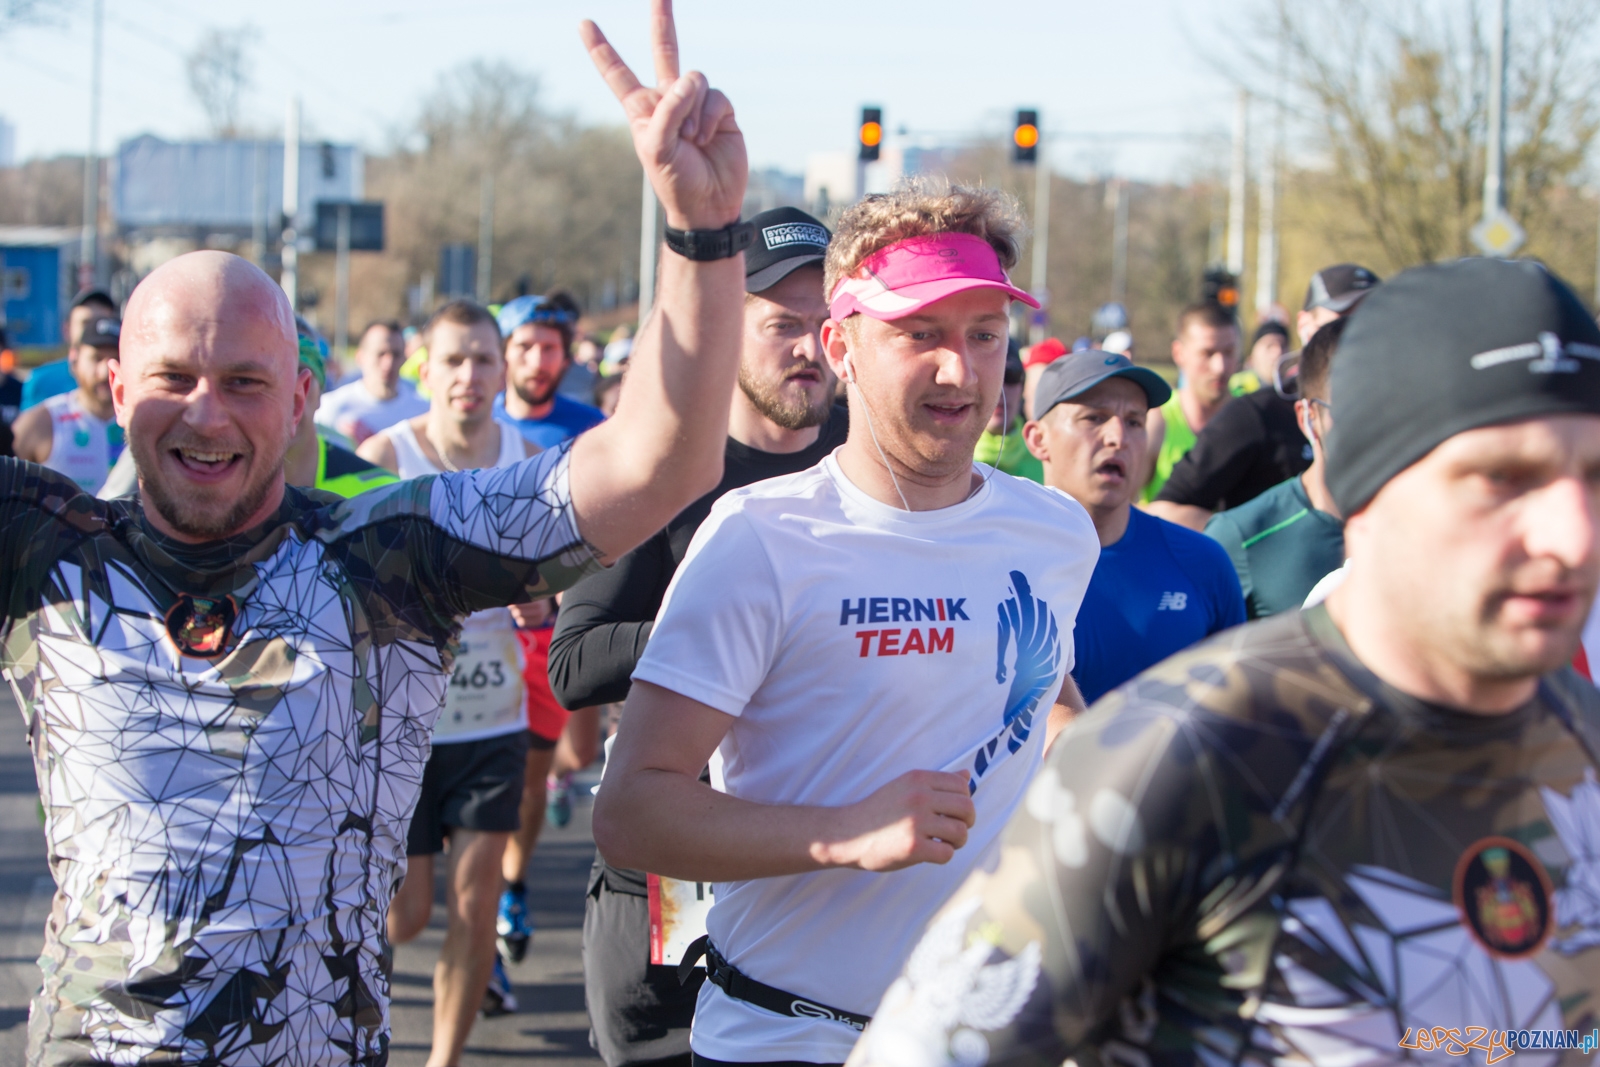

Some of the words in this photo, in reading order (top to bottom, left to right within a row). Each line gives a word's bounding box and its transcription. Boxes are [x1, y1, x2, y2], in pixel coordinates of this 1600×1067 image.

[767, 226, 823, 238] BYDGOSZCZ
[768, 234, 826, 245] TRIATHLON
[839, 597, 971, 626] HERNIK
[1157, 591, 1188, 611] NB
[855, 627, 954, 658] TEAM
[450, 660, 506, 689] 463
